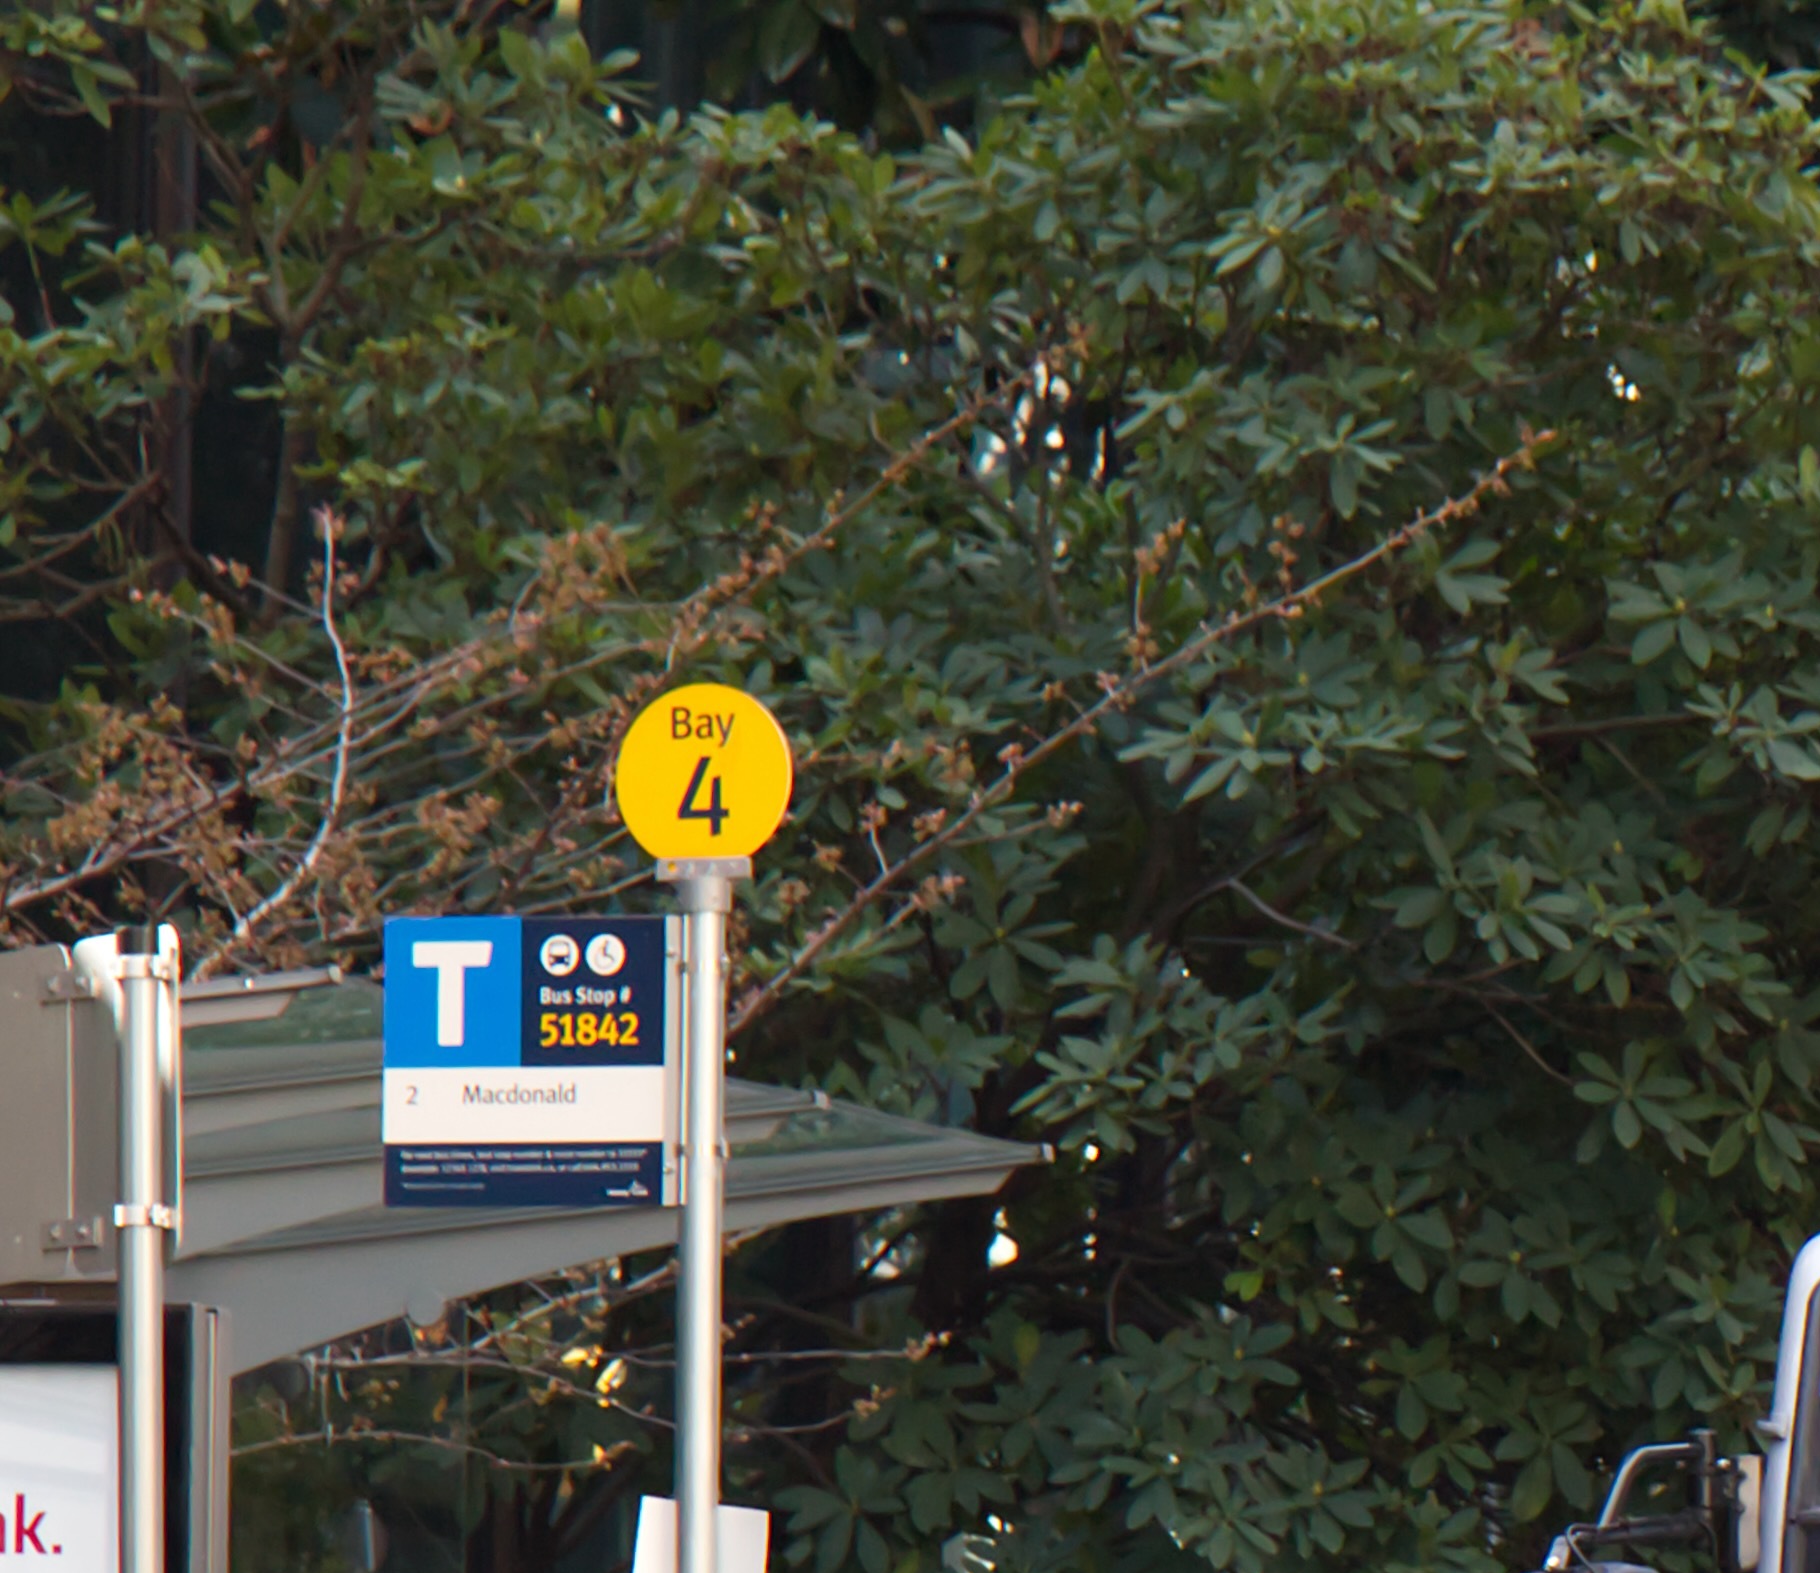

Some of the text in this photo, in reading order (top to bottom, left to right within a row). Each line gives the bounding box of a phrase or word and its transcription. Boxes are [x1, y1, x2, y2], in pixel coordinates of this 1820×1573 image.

[671, 706, 735, 748] Bay
[677, 756, 730, 837] 4
[412, 940, 493, 1047] T
[539, 985, 632, 1008] Bus Stop #
[539, 1012, 639, 1047] 51842
[405, 1084, 577, 1105] 2 Macdonald
